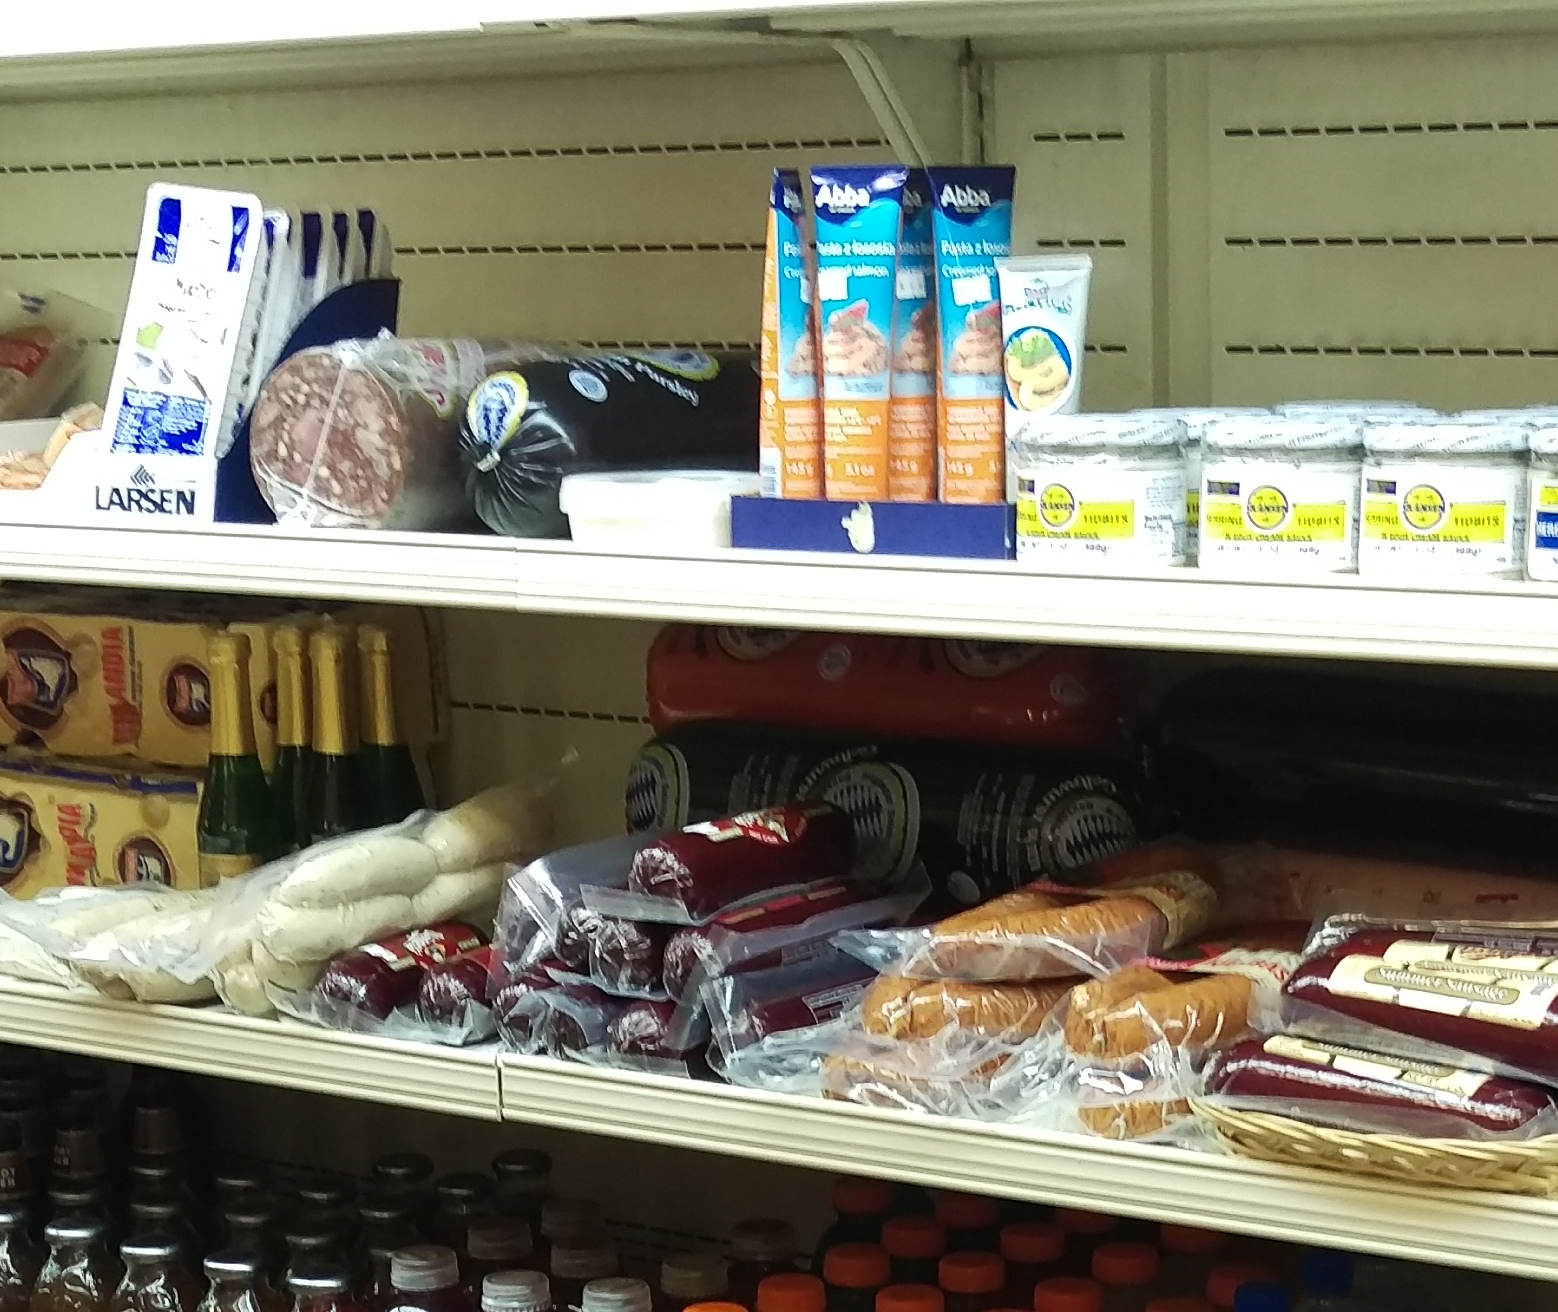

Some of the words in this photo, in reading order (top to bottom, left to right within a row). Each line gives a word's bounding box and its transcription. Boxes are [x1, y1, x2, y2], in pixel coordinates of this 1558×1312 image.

[816, 184, 870, 207] Abba
[941, 184, 991, 207] Abba
[95, 485, 196, 516] LARSEN
